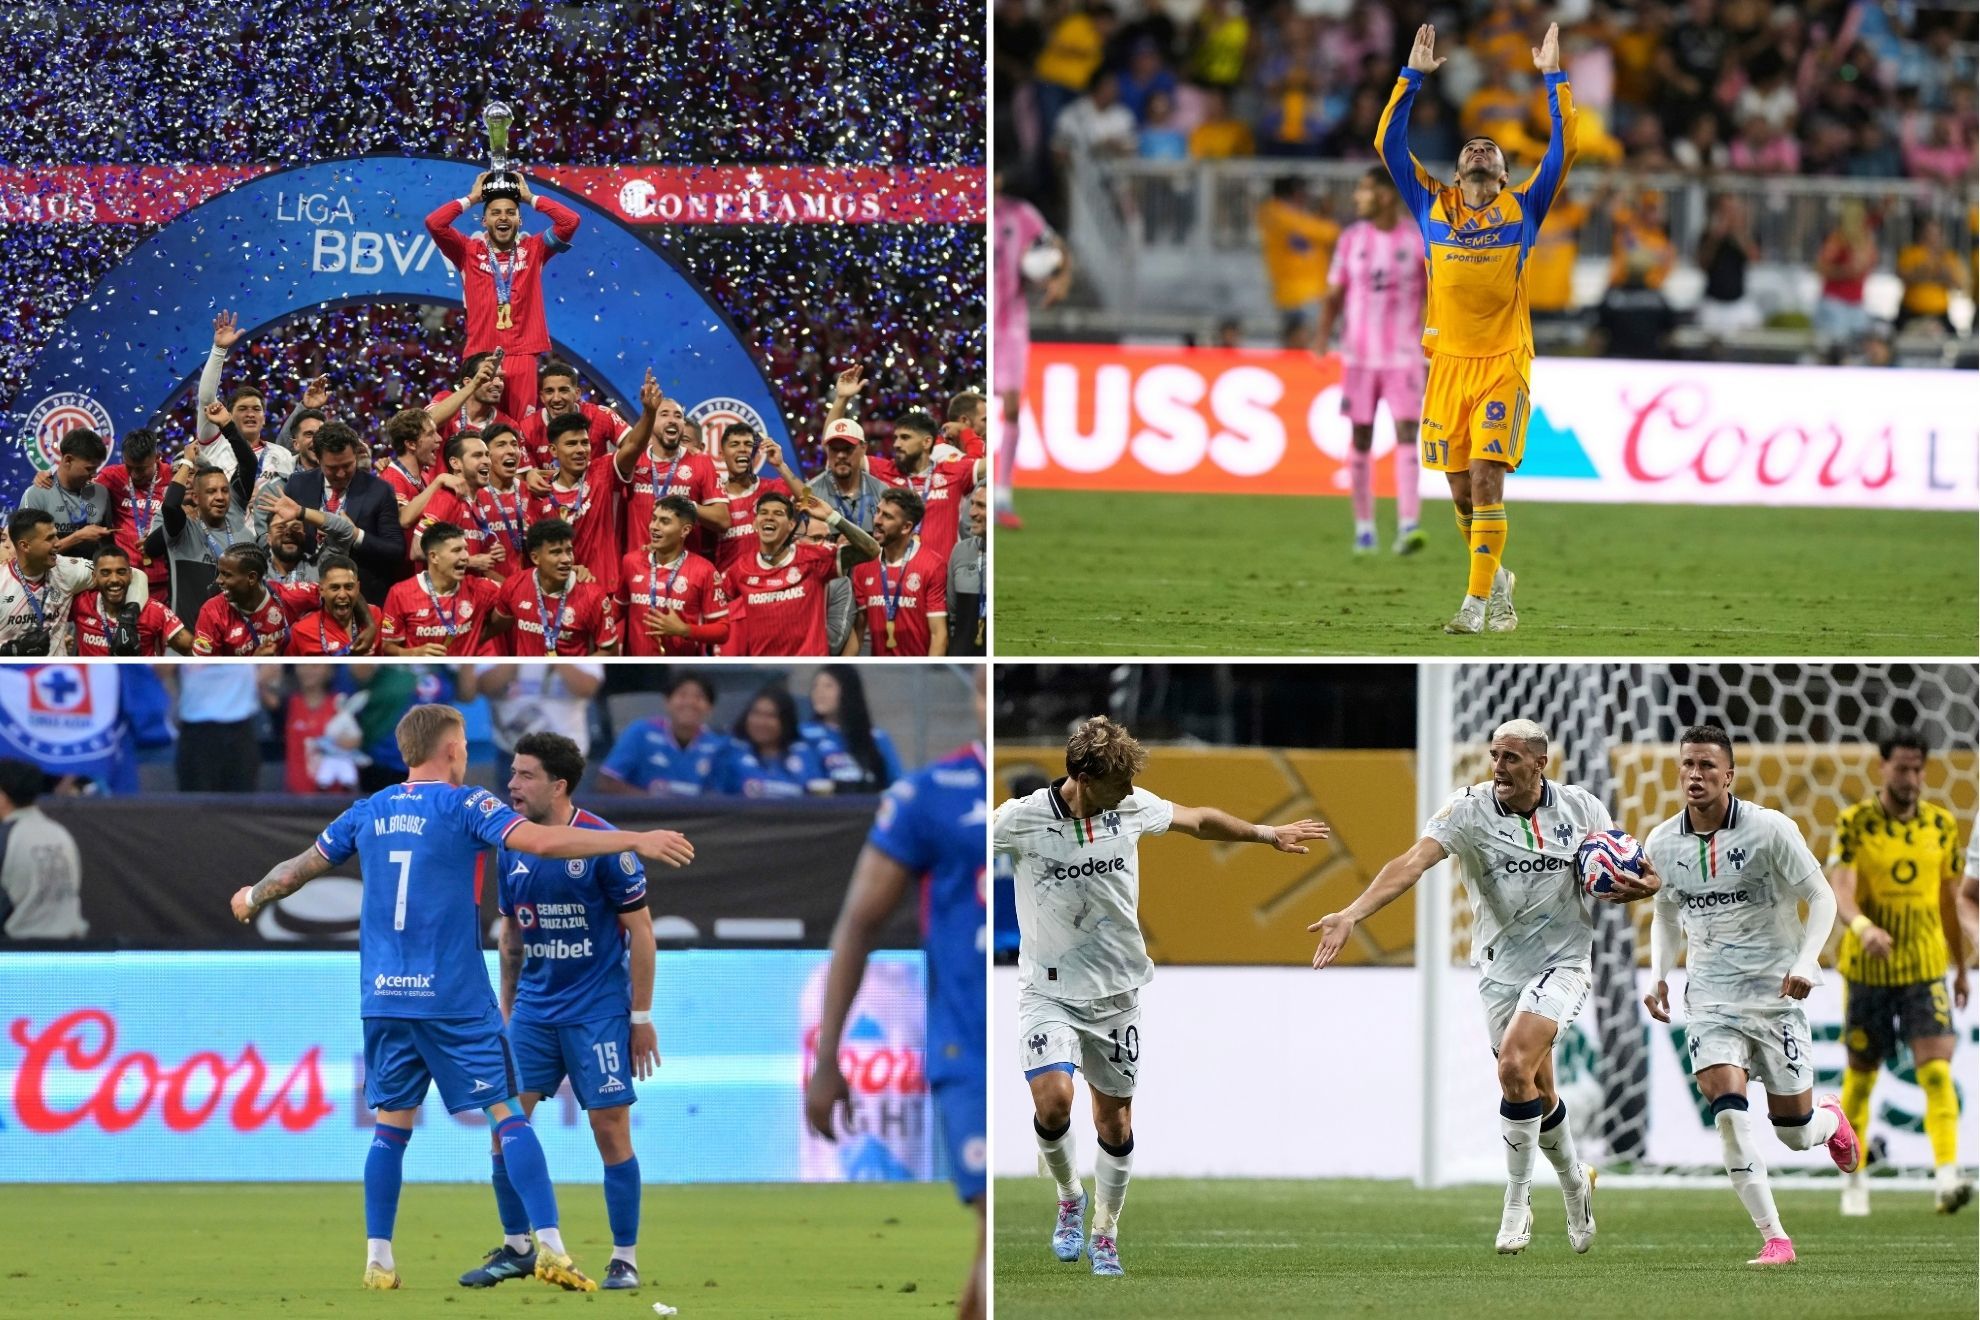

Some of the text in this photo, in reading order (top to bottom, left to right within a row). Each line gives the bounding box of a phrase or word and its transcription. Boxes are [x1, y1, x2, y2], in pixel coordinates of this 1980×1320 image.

[277, 191, 354, 225] LIGA
[312, 229, 457, 276] BBVA
[1618, 379, 1897, 489] Coors
[374, 814, 427, 837] M.BOGUSZ
[1054, 856, 1125, 881] codere
[1505, 854, 1570, 874] coder
[389, 850, 413, 931] 7
[1687, 889, 1750, 909] codere
[536, 903, 586, 916] CEMENTO
[592, 1041, 620, 1074] 15
[1107, 1024, 1139, 1063] 10
[8, 1007, 335, 1134] Coors
[598, 1083, 627, 1094] PIRMA
